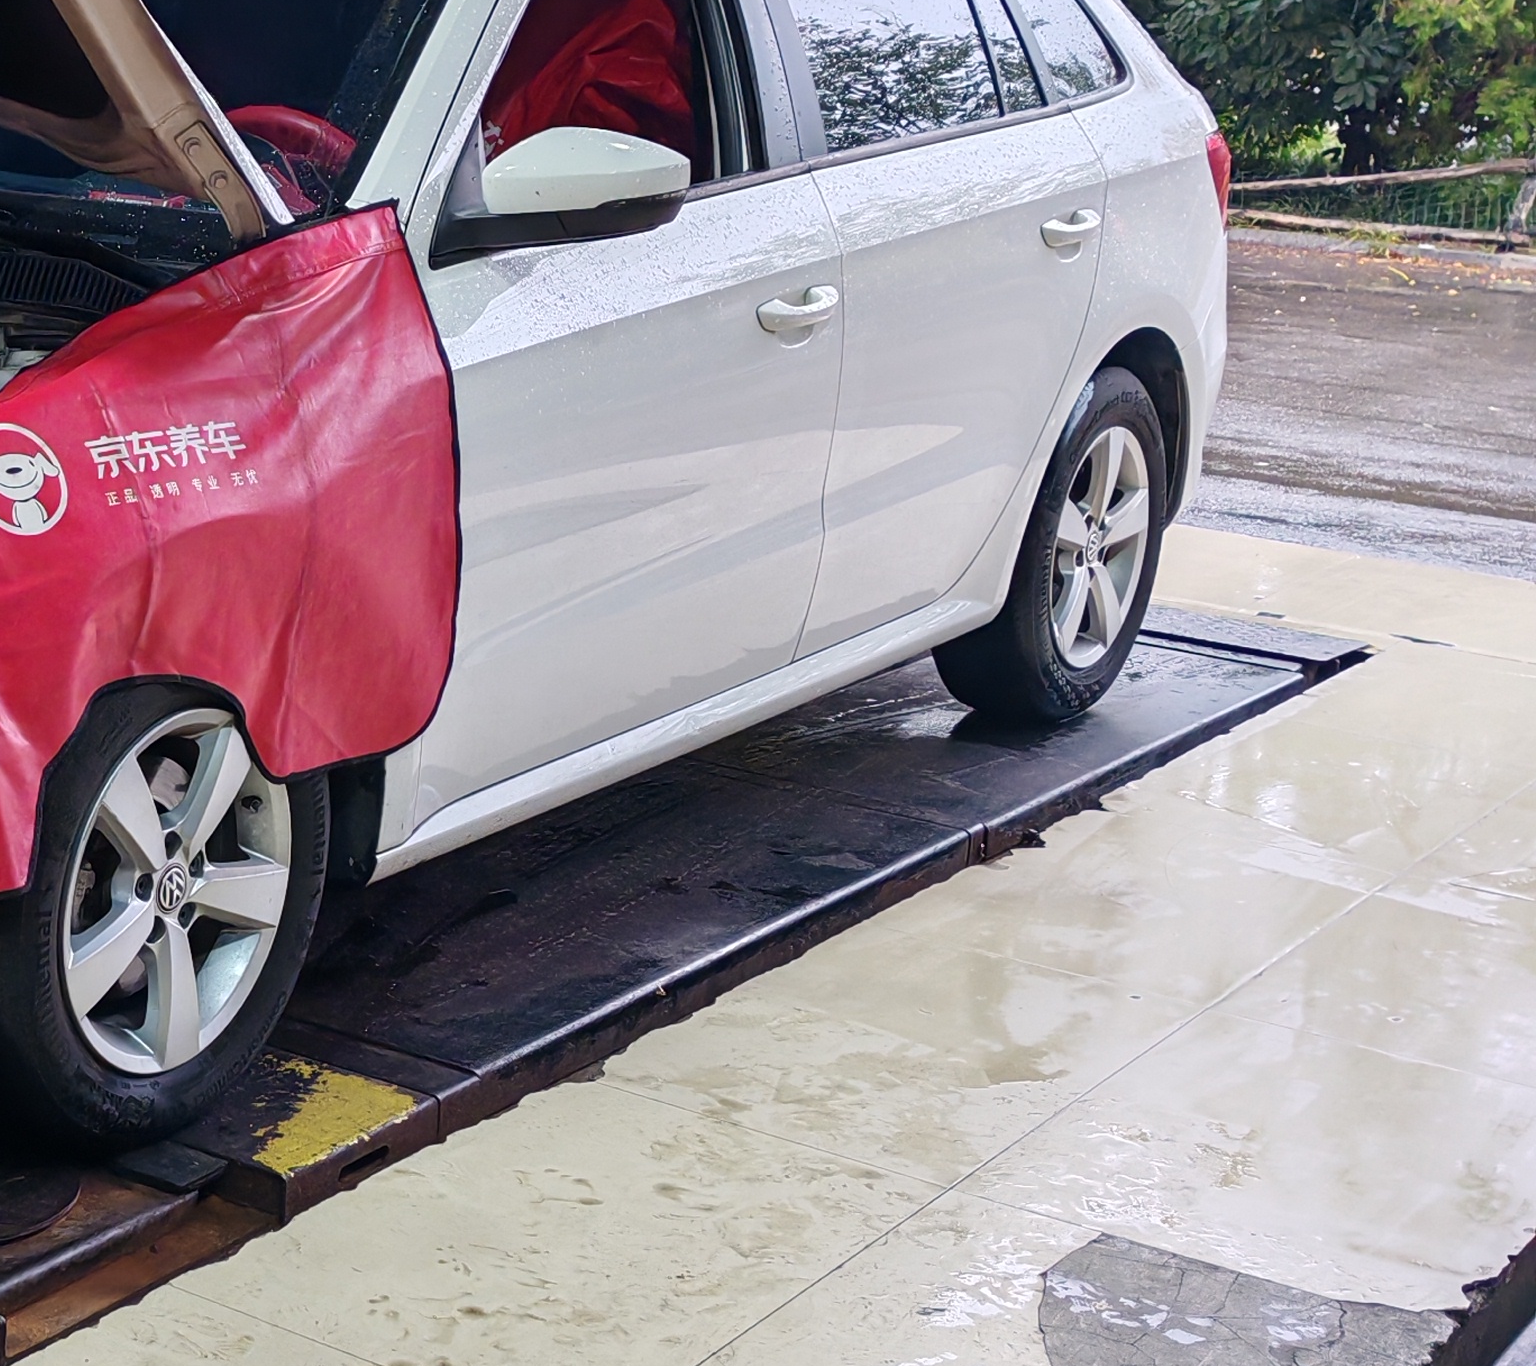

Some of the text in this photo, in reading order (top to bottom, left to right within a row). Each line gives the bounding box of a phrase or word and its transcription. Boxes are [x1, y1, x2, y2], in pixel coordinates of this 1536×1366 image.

[84, 421, 247, 480] 京东养车
[105, 468, 260, 507] 正品 透明 专业 无忧
